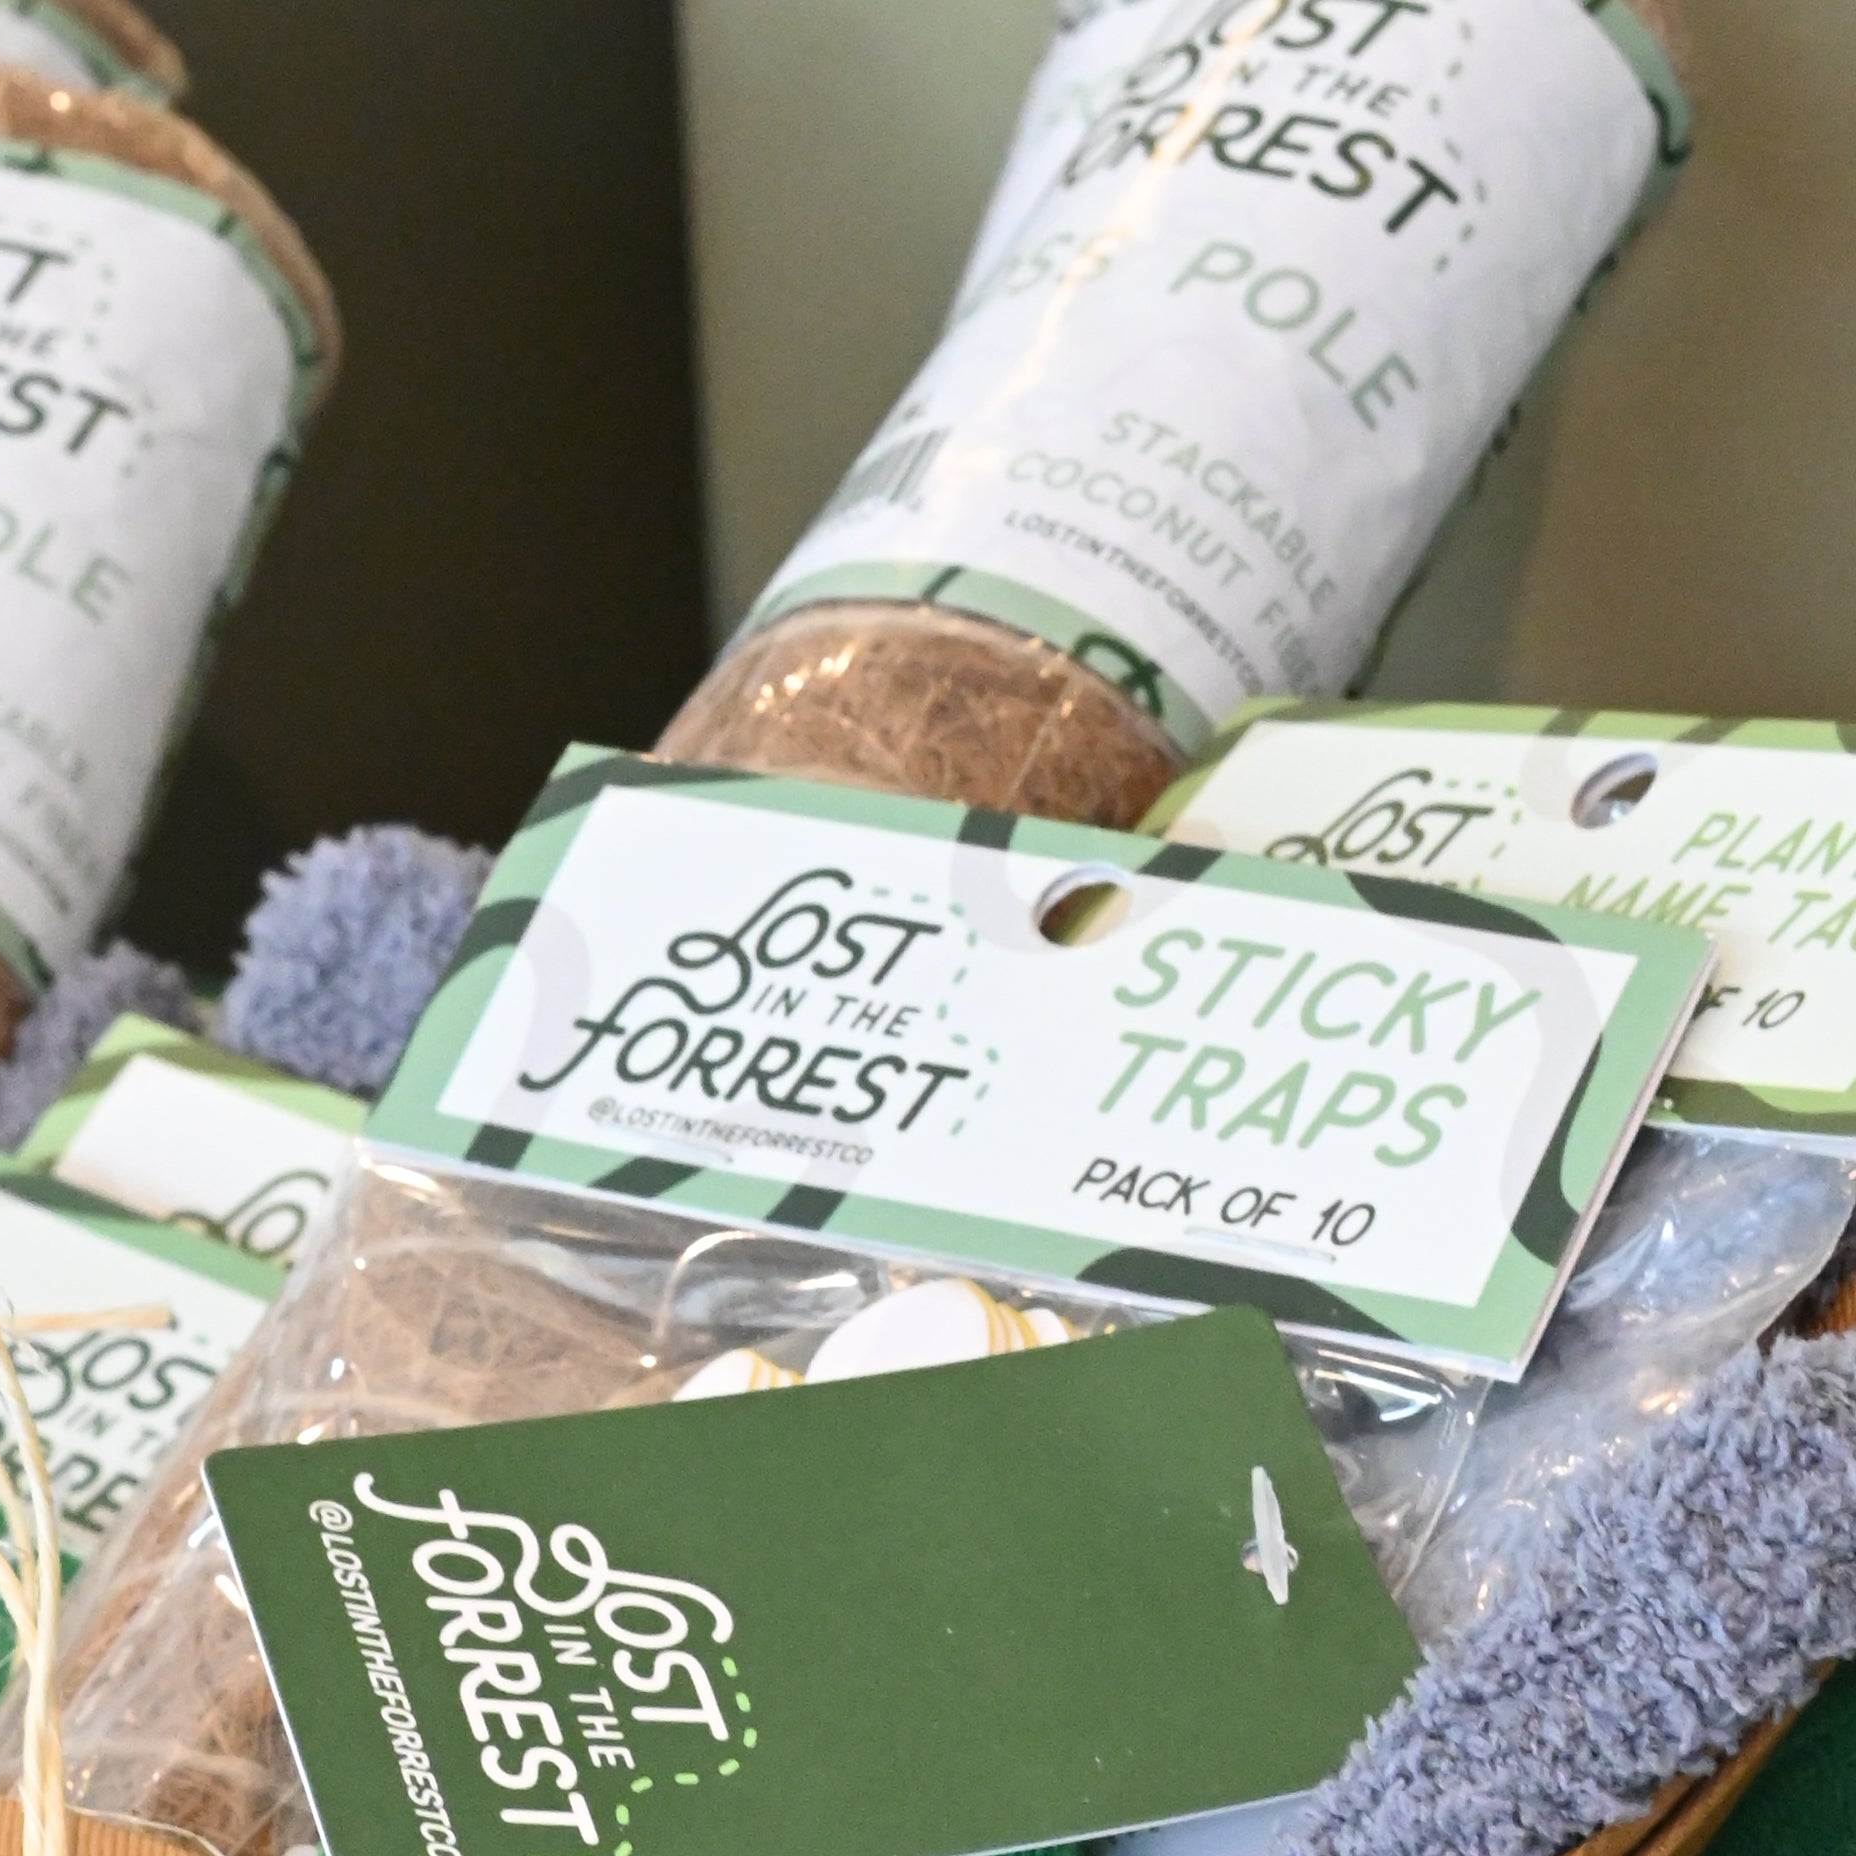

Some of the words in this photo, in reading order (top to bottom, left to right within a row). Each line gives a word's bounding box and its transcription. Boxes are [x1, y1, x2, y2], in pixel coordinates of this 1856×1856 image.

[1293, 64, 1412, 120] THE
[1169, 239, 1419, 434] POLE
[1005, 449, 1254, 589] COCONUT
[1100, 410, 1339, 618] STACKABLE
[1263, 767, 1496, 869] LOST
[1670, 808, 1856, 879] PLAN
[667, 867, 943, 1015] LOST
[1559, 871, 1754, 927] NAME
[1766, 889, 1856, 953] TA
[749, 983, 809, 1019] IN
[827, 994, 922, 1039] THE
[1112, 927, 1542, 1064] STICKY
[1741, 988, 1808, 1030] 10
[586, 1095, 876, 1166] @LOSTINTHEFORRESTCO
[1096, 1031, 1469, 1169] TRAPS
[1071, 1156, 1212, 1220] PACK
[1219, 1186, 1298, 1229] OF
[1309, 1199, 1378, 1249] 10
[543, 1623, 599, 1666] IN
[549, 1522, 736, 1743] LOST
[568, 1685, 637, 1771] THE
